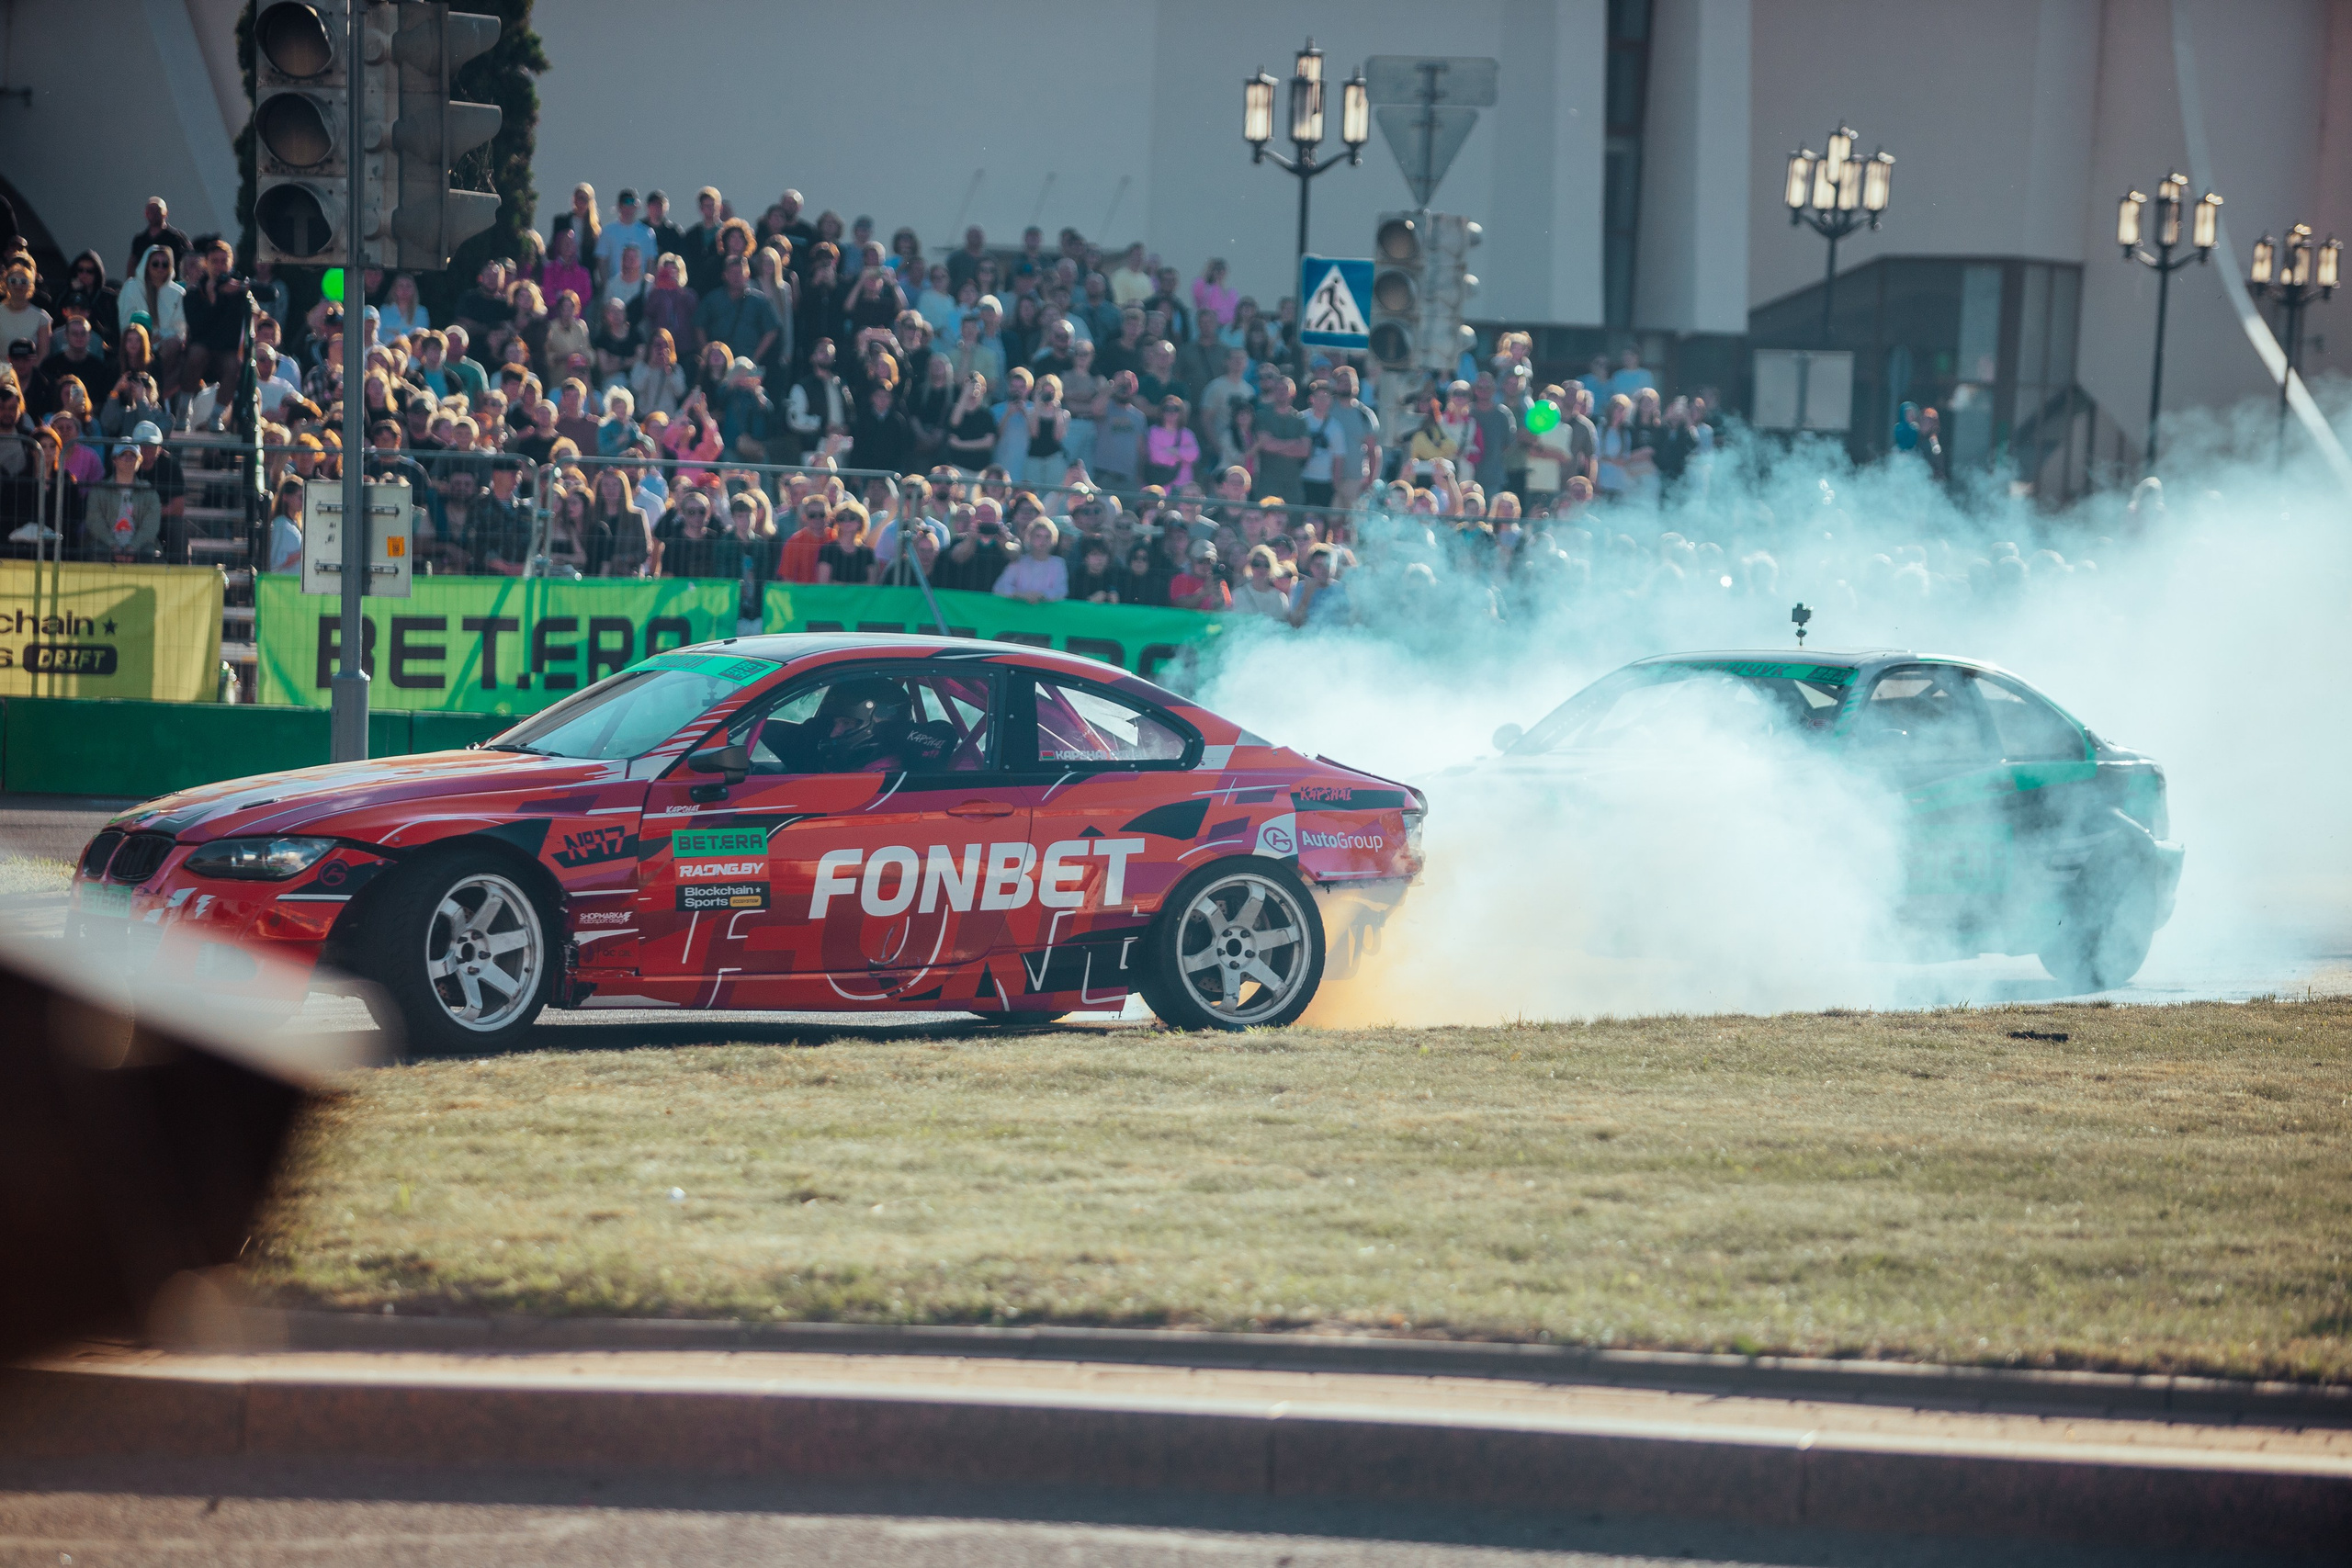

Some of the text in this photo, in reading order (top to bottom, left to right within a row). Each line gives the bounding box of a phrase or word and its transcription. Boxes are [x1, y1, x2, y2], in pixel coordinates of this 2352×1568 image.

[38, 648, 106, 671] DRIFT
[678, 834, 763, 850] BET.ERA
[1302, 830, 1383, 852] AutoGroup
[679, 863, 764, 877] RACING.BY
[808, 838, 1146, 919] FONBET
[684, 886, 753, 897] Blockchain
[684, 897, 729, 908] Sports
[580, 911, 625, 919] SHOPMARKA
